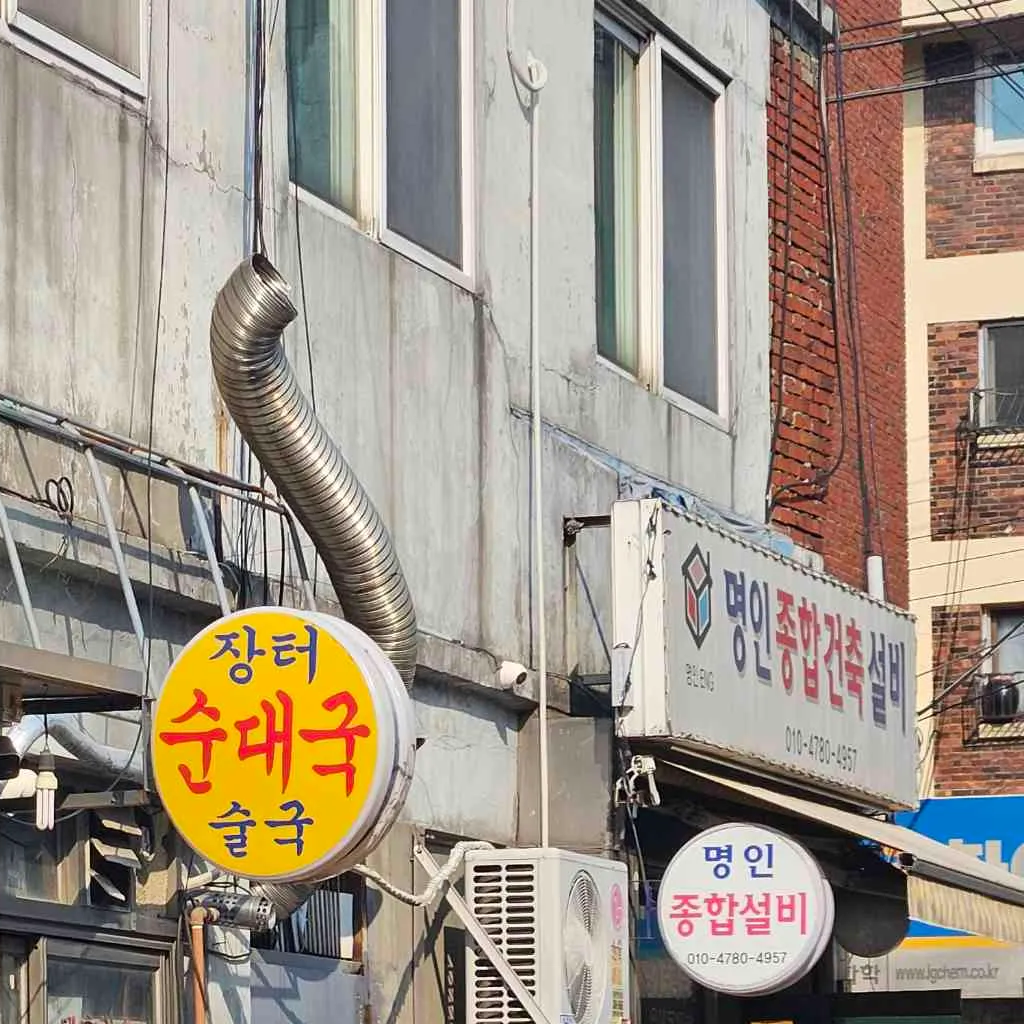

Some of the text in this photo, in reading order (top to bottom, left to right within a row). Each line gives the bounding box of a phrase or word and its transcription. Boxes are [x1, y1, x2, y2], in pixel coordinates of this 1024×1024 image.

[723, 568, 773, 684] 명인
[208, 624, 319, 685] 장터
[159, 688, 371, 798] 순대국
[784, 724, 858, 774] 010-4780-4957
[207, 800, 314, 858] 술국
[702, 844, 775, 879] 명인
[669, 891, 808, 938] 종합설비
[686, 950, 788, 966] 010-4780-4957
